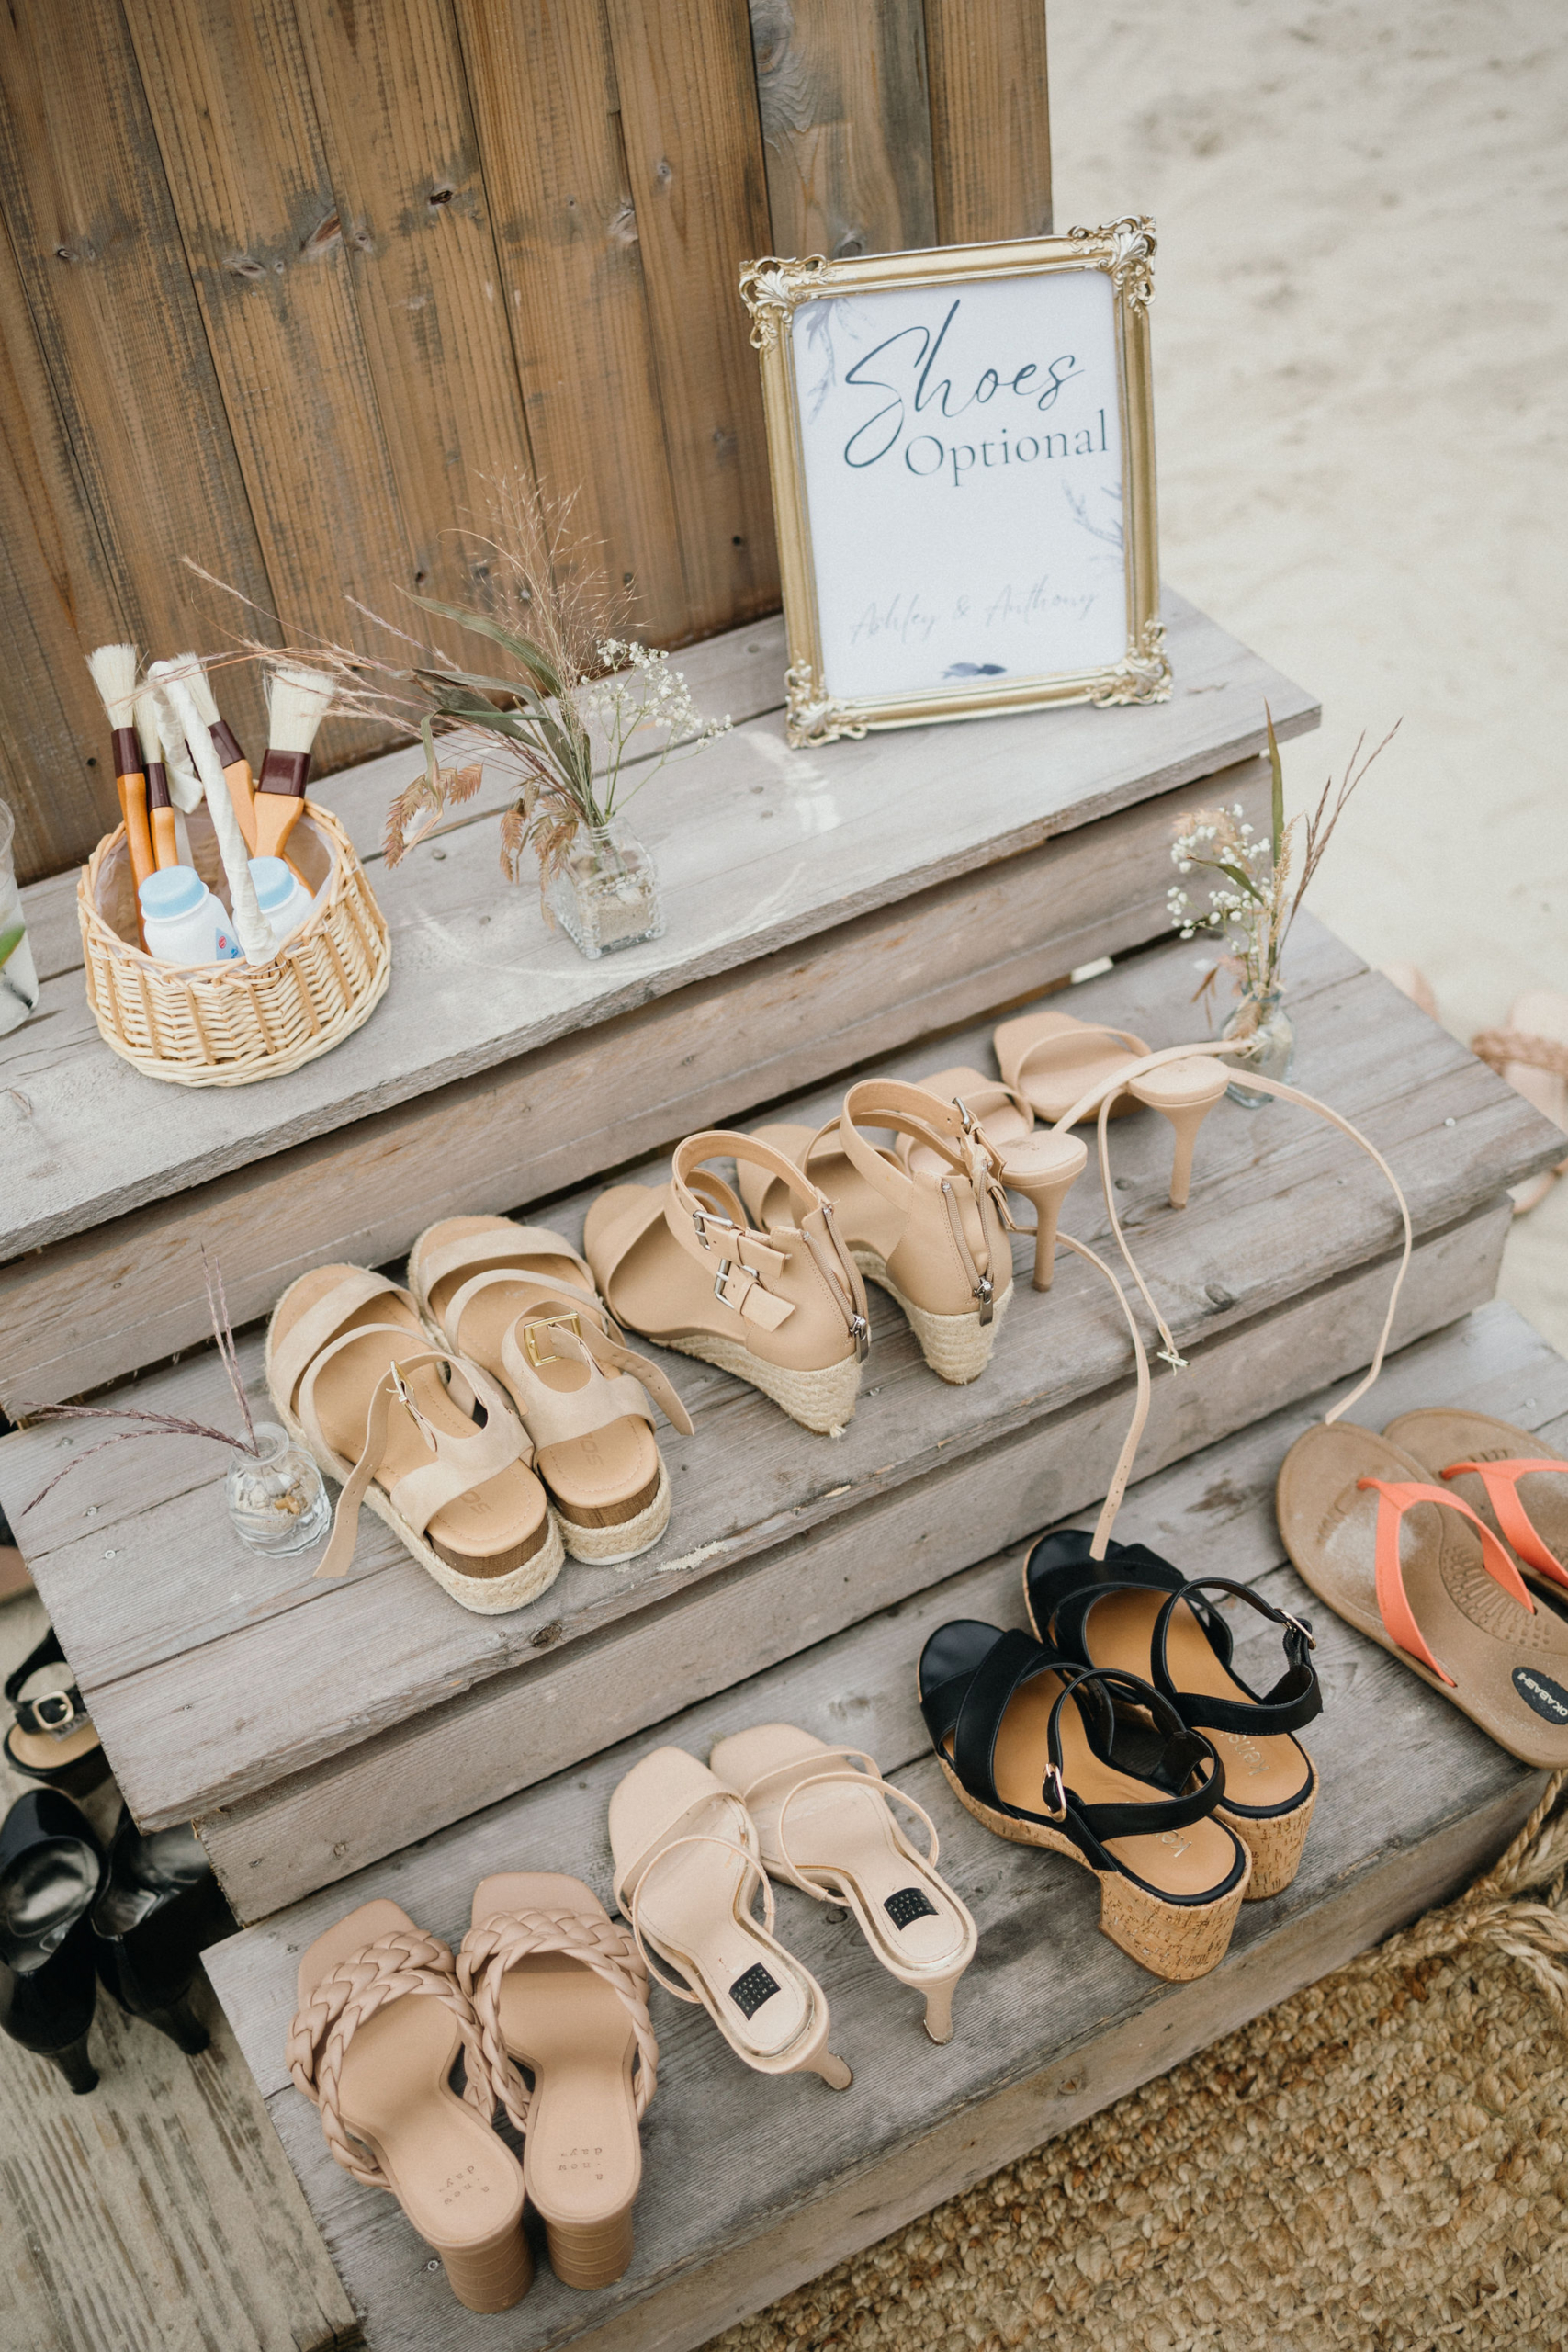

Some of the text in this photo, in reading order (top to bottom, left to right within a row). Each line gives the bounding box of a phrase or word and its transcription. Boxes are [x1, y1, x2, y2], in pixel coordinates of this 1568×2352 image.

[844, 299, 1086, 469] Shoes
[905, 408, 1110, 487] Optional
[849, 574, 1099, 644] Ashley & Anthony
[1517, 1672, 1568, 1716] OKABASHI
